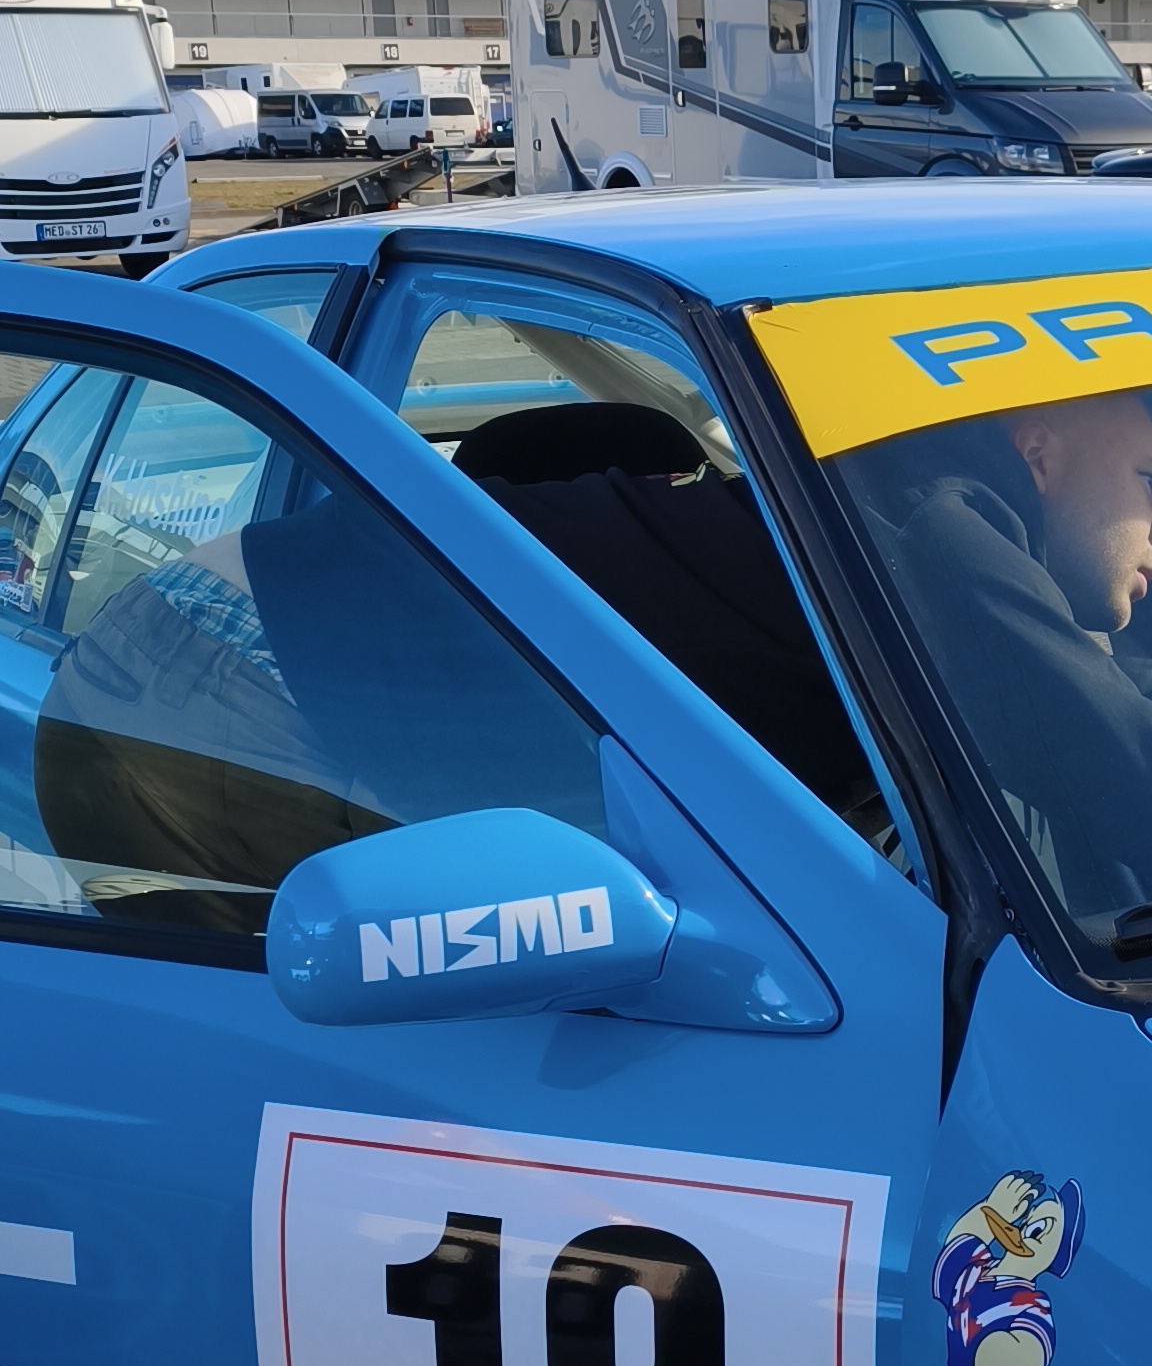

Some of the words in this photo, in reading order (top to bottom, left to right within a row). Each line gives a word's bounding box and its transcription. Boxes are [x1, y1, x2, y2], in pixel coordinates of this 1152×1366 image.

[192, 45, 207, 58] 19
[384, 46, 398, 59] 18
[486, 46, 499, 59] 17
[44, 225, 65, 237] MED
[71, 224, 84, 236] ST
[86, 224, 98, 235] 26
[359, 886, 614, 983] NISMO
